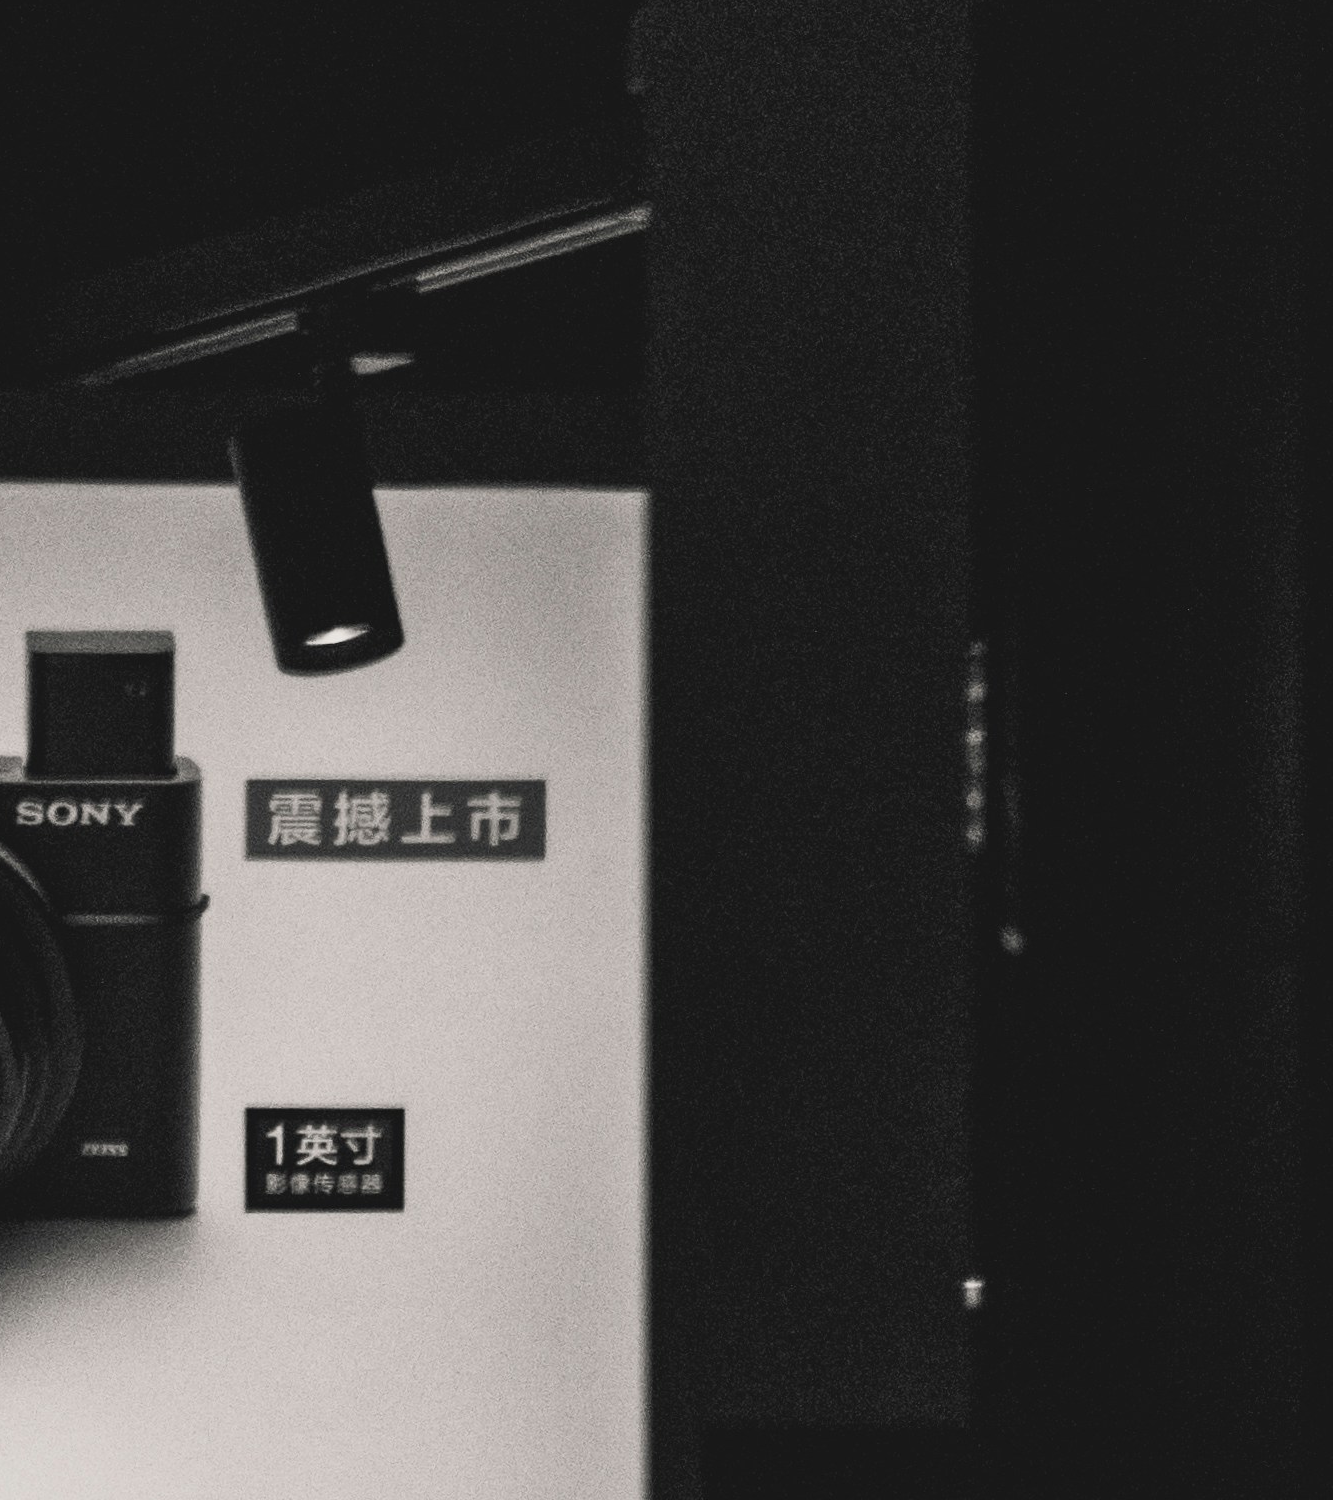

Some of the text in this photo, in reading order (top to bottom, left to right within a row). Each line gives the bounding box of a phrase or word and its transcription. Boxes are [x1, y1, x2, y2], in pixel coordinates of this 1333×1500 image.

[16, 800, 143, 827] SONY
[267, 791, 522, 848] 震撼上市
[266, 1123, 383, 1166] 1英寸
